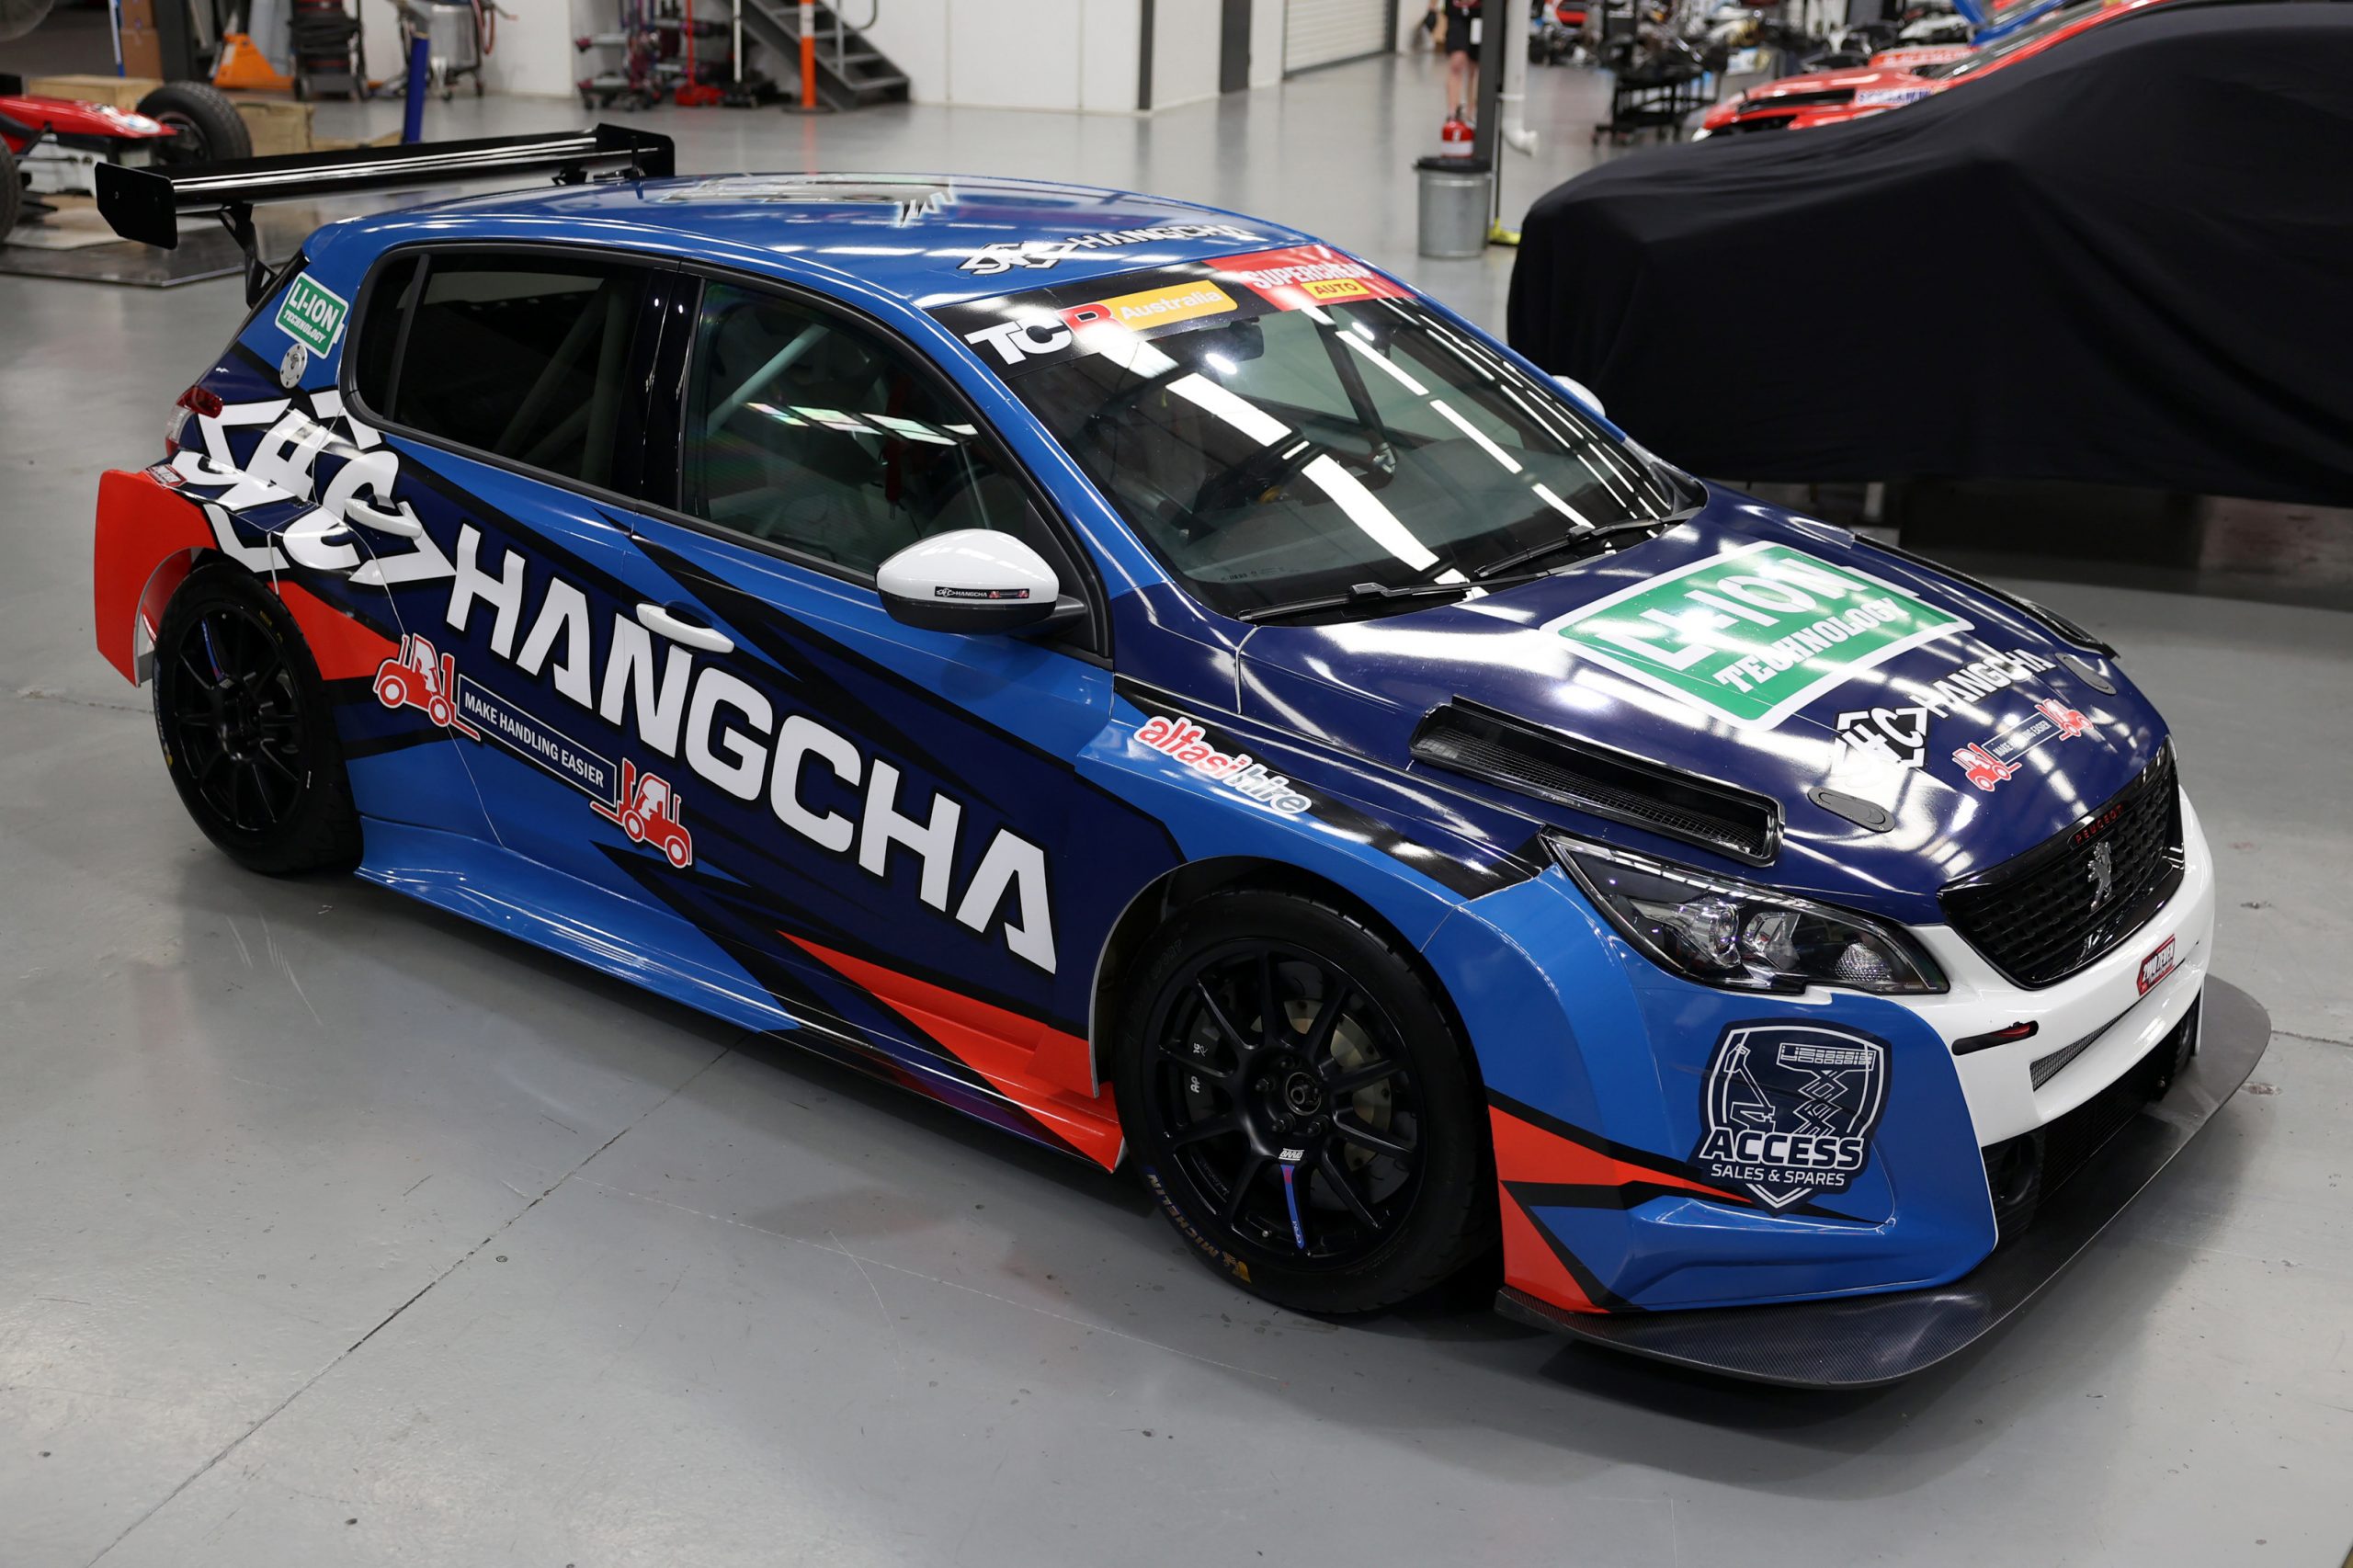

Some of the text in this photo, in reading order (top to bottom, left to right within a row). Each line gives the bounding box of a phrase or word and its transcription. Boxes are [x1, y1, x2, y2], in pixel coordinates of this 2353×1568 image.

[289, 282, 339, 332] LI-ION
[1119, 290, 1223, 321] Australia
[1314, 282, 1358, 295] AUTO
[283, 309, 326, 344] TECHNOLOGY
[1712, 597, 1912, 693] TECHNOLOGY
[446, 522, 1057, 975] HANGCHA
[465, 691, 604, 789] MAKE HANDLING EASIER
[2075, 803, 2122, 844] PEUGEOT
[1279, 1148, 1304, 1161] BRAID
[1699, 1126, 1865, 1170] ACCESS
[1711, 1164, 1846, 1186] SALES & SPARES
[1147, 1174, 1219, 1257] MICHELIN
